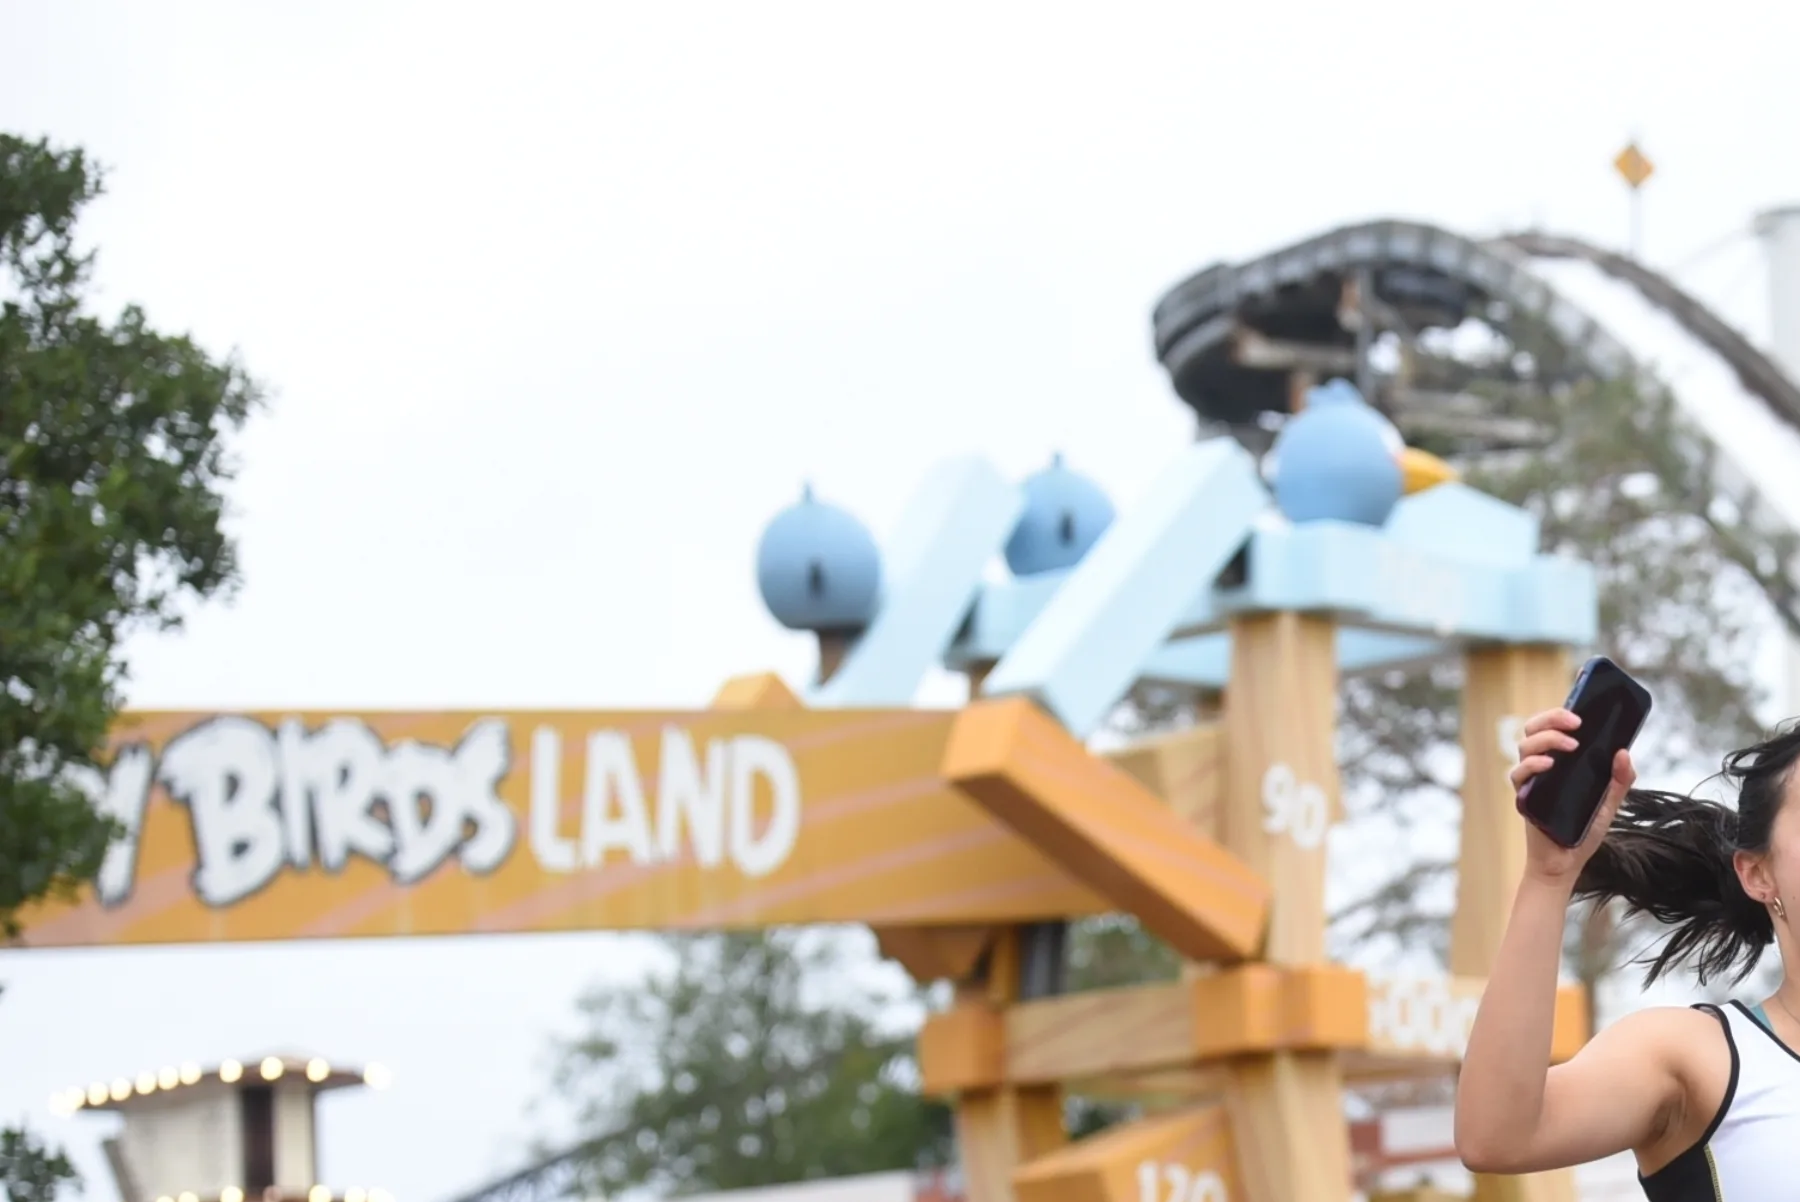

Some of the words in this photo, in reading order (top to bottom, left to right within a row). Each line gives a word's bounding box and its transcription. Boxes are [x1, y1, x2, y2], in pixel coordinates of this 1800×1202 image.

[155, 714, 516, 907] BIRDS
[530, 726, 800, 877] LAND
[1261, 763, 1329, 849] 90
